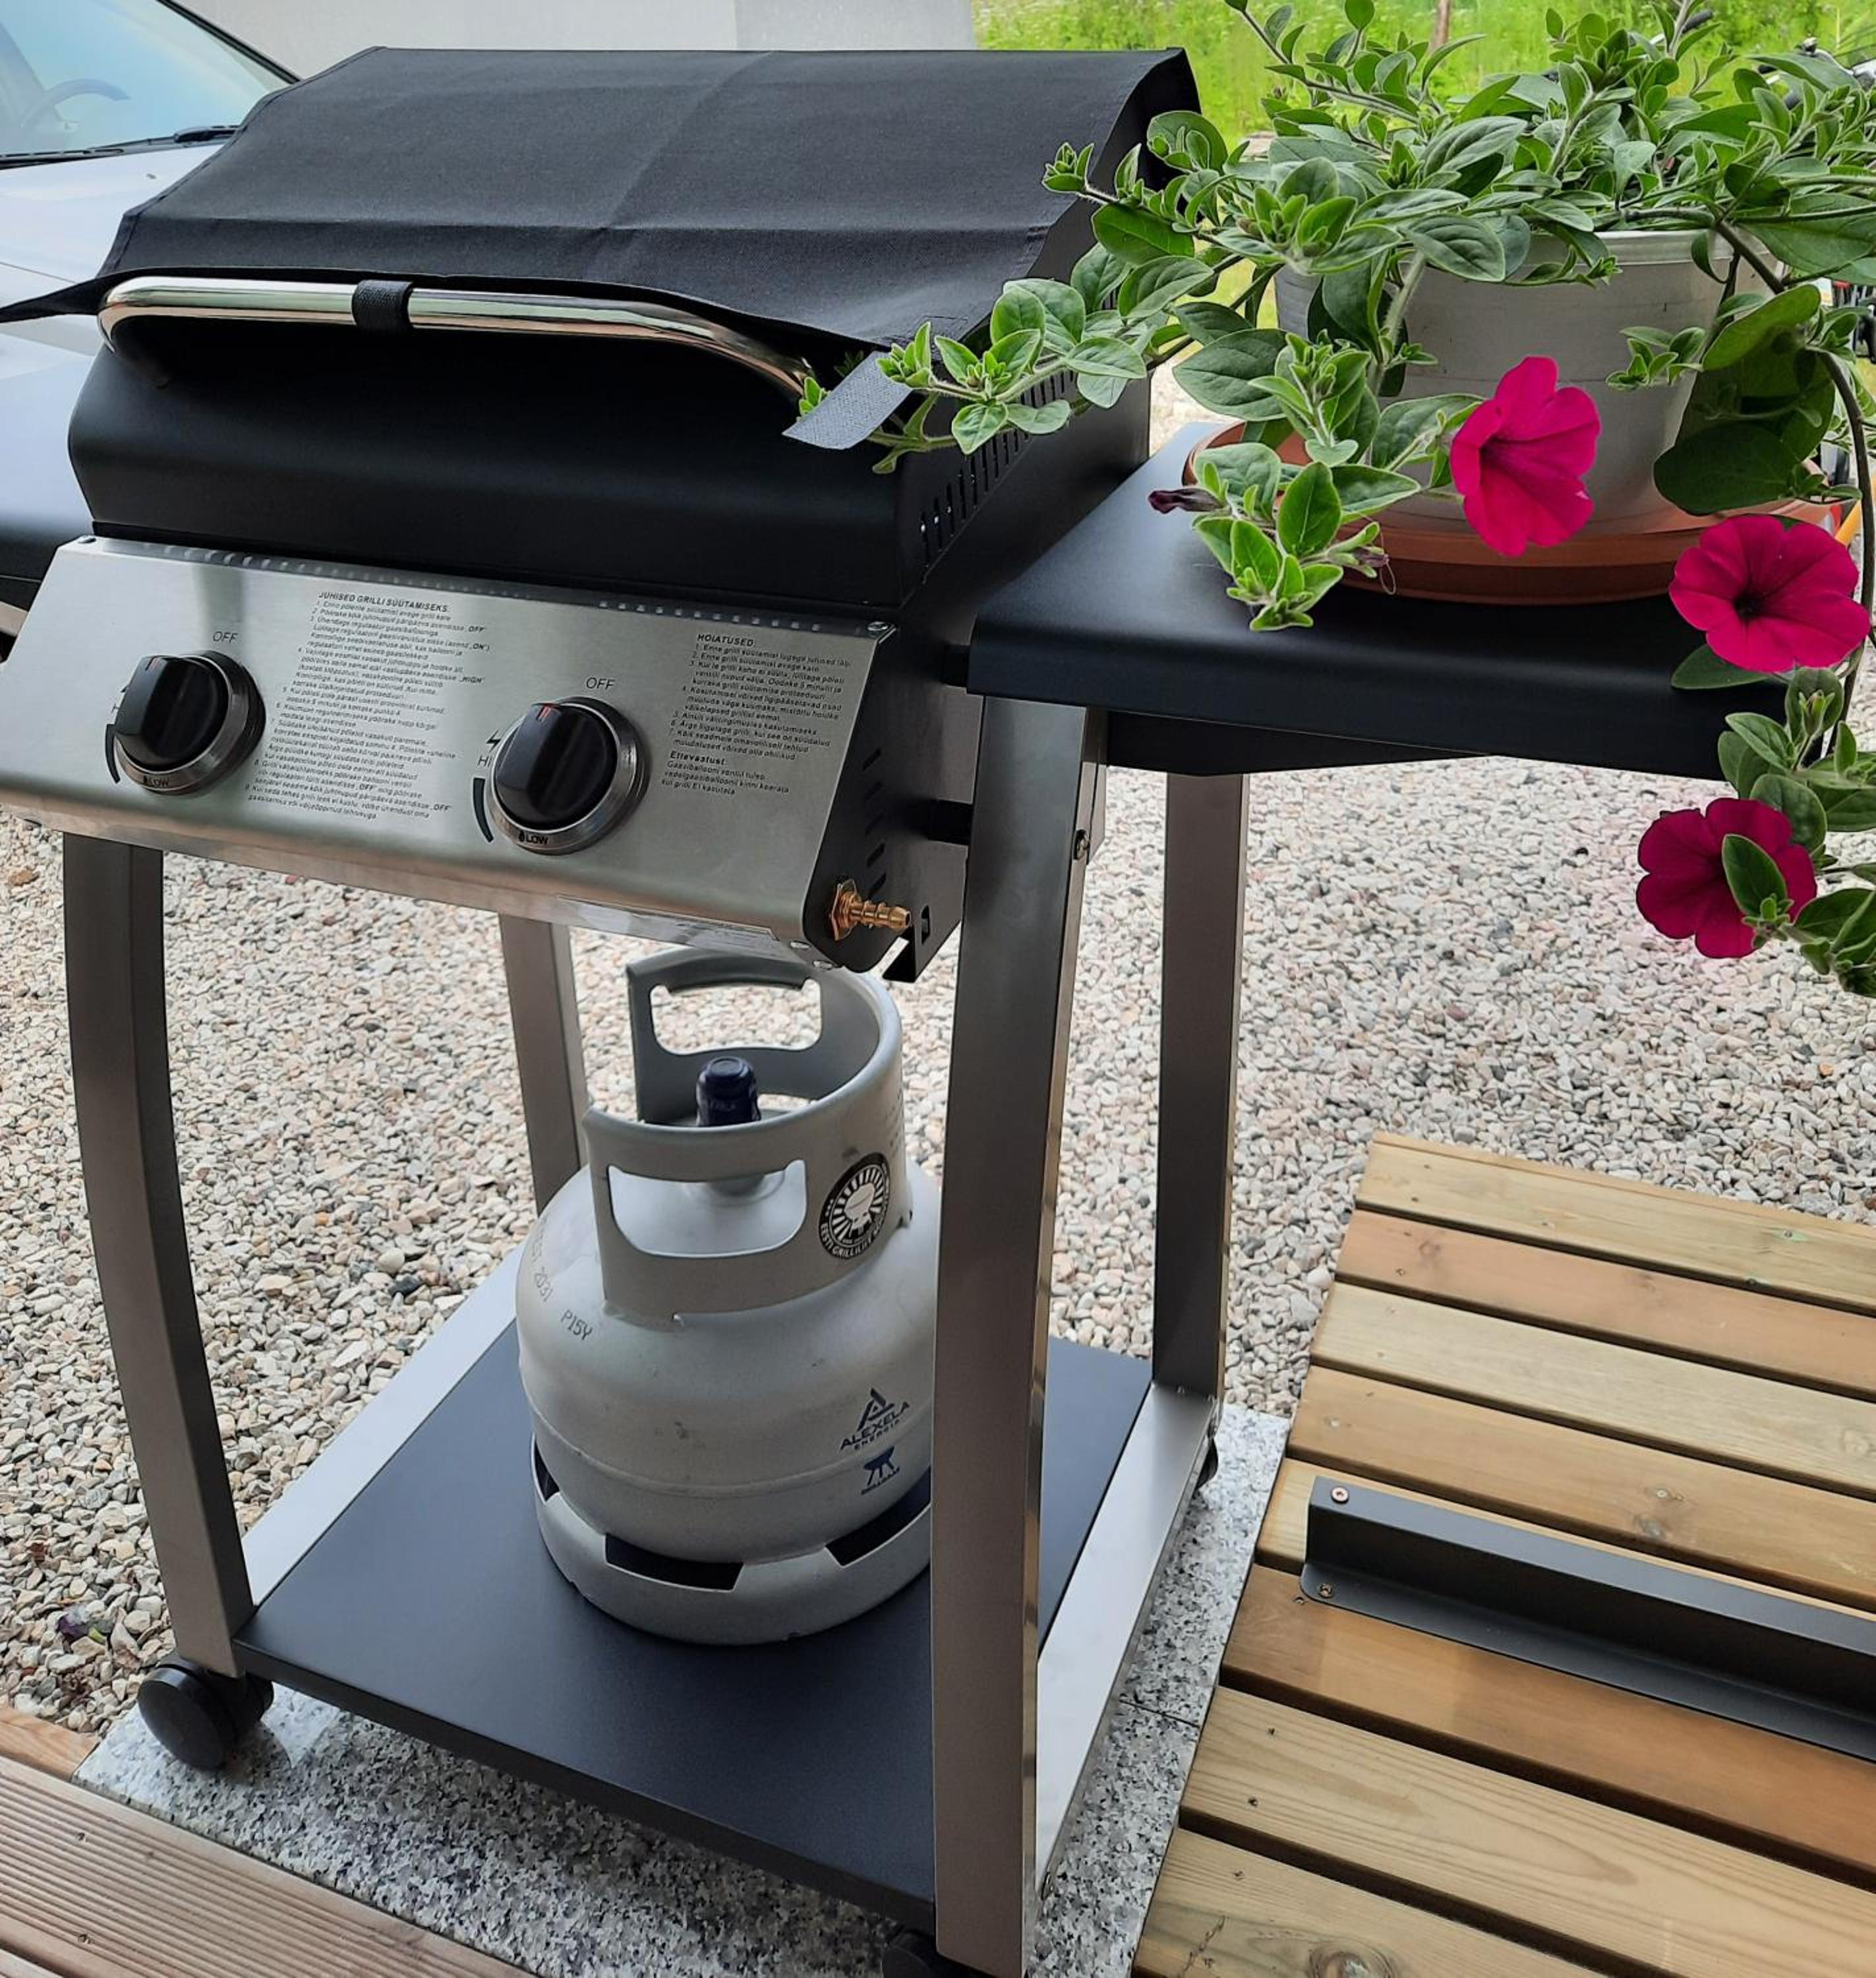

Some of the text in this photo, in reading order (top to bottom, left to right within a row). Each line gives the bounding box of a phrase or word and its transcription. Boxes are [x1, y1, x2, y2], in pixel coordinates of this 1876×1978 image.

[356, 594, 386, 605] GRILLI
[212, 631, 239, 644] OFF
[585, 677, 616, 690] OFF
[147, 779, 170, 787] LOW
[525, 835, 548, 844] LOW
[840, 1400, 912, 1451] ALEXELA
